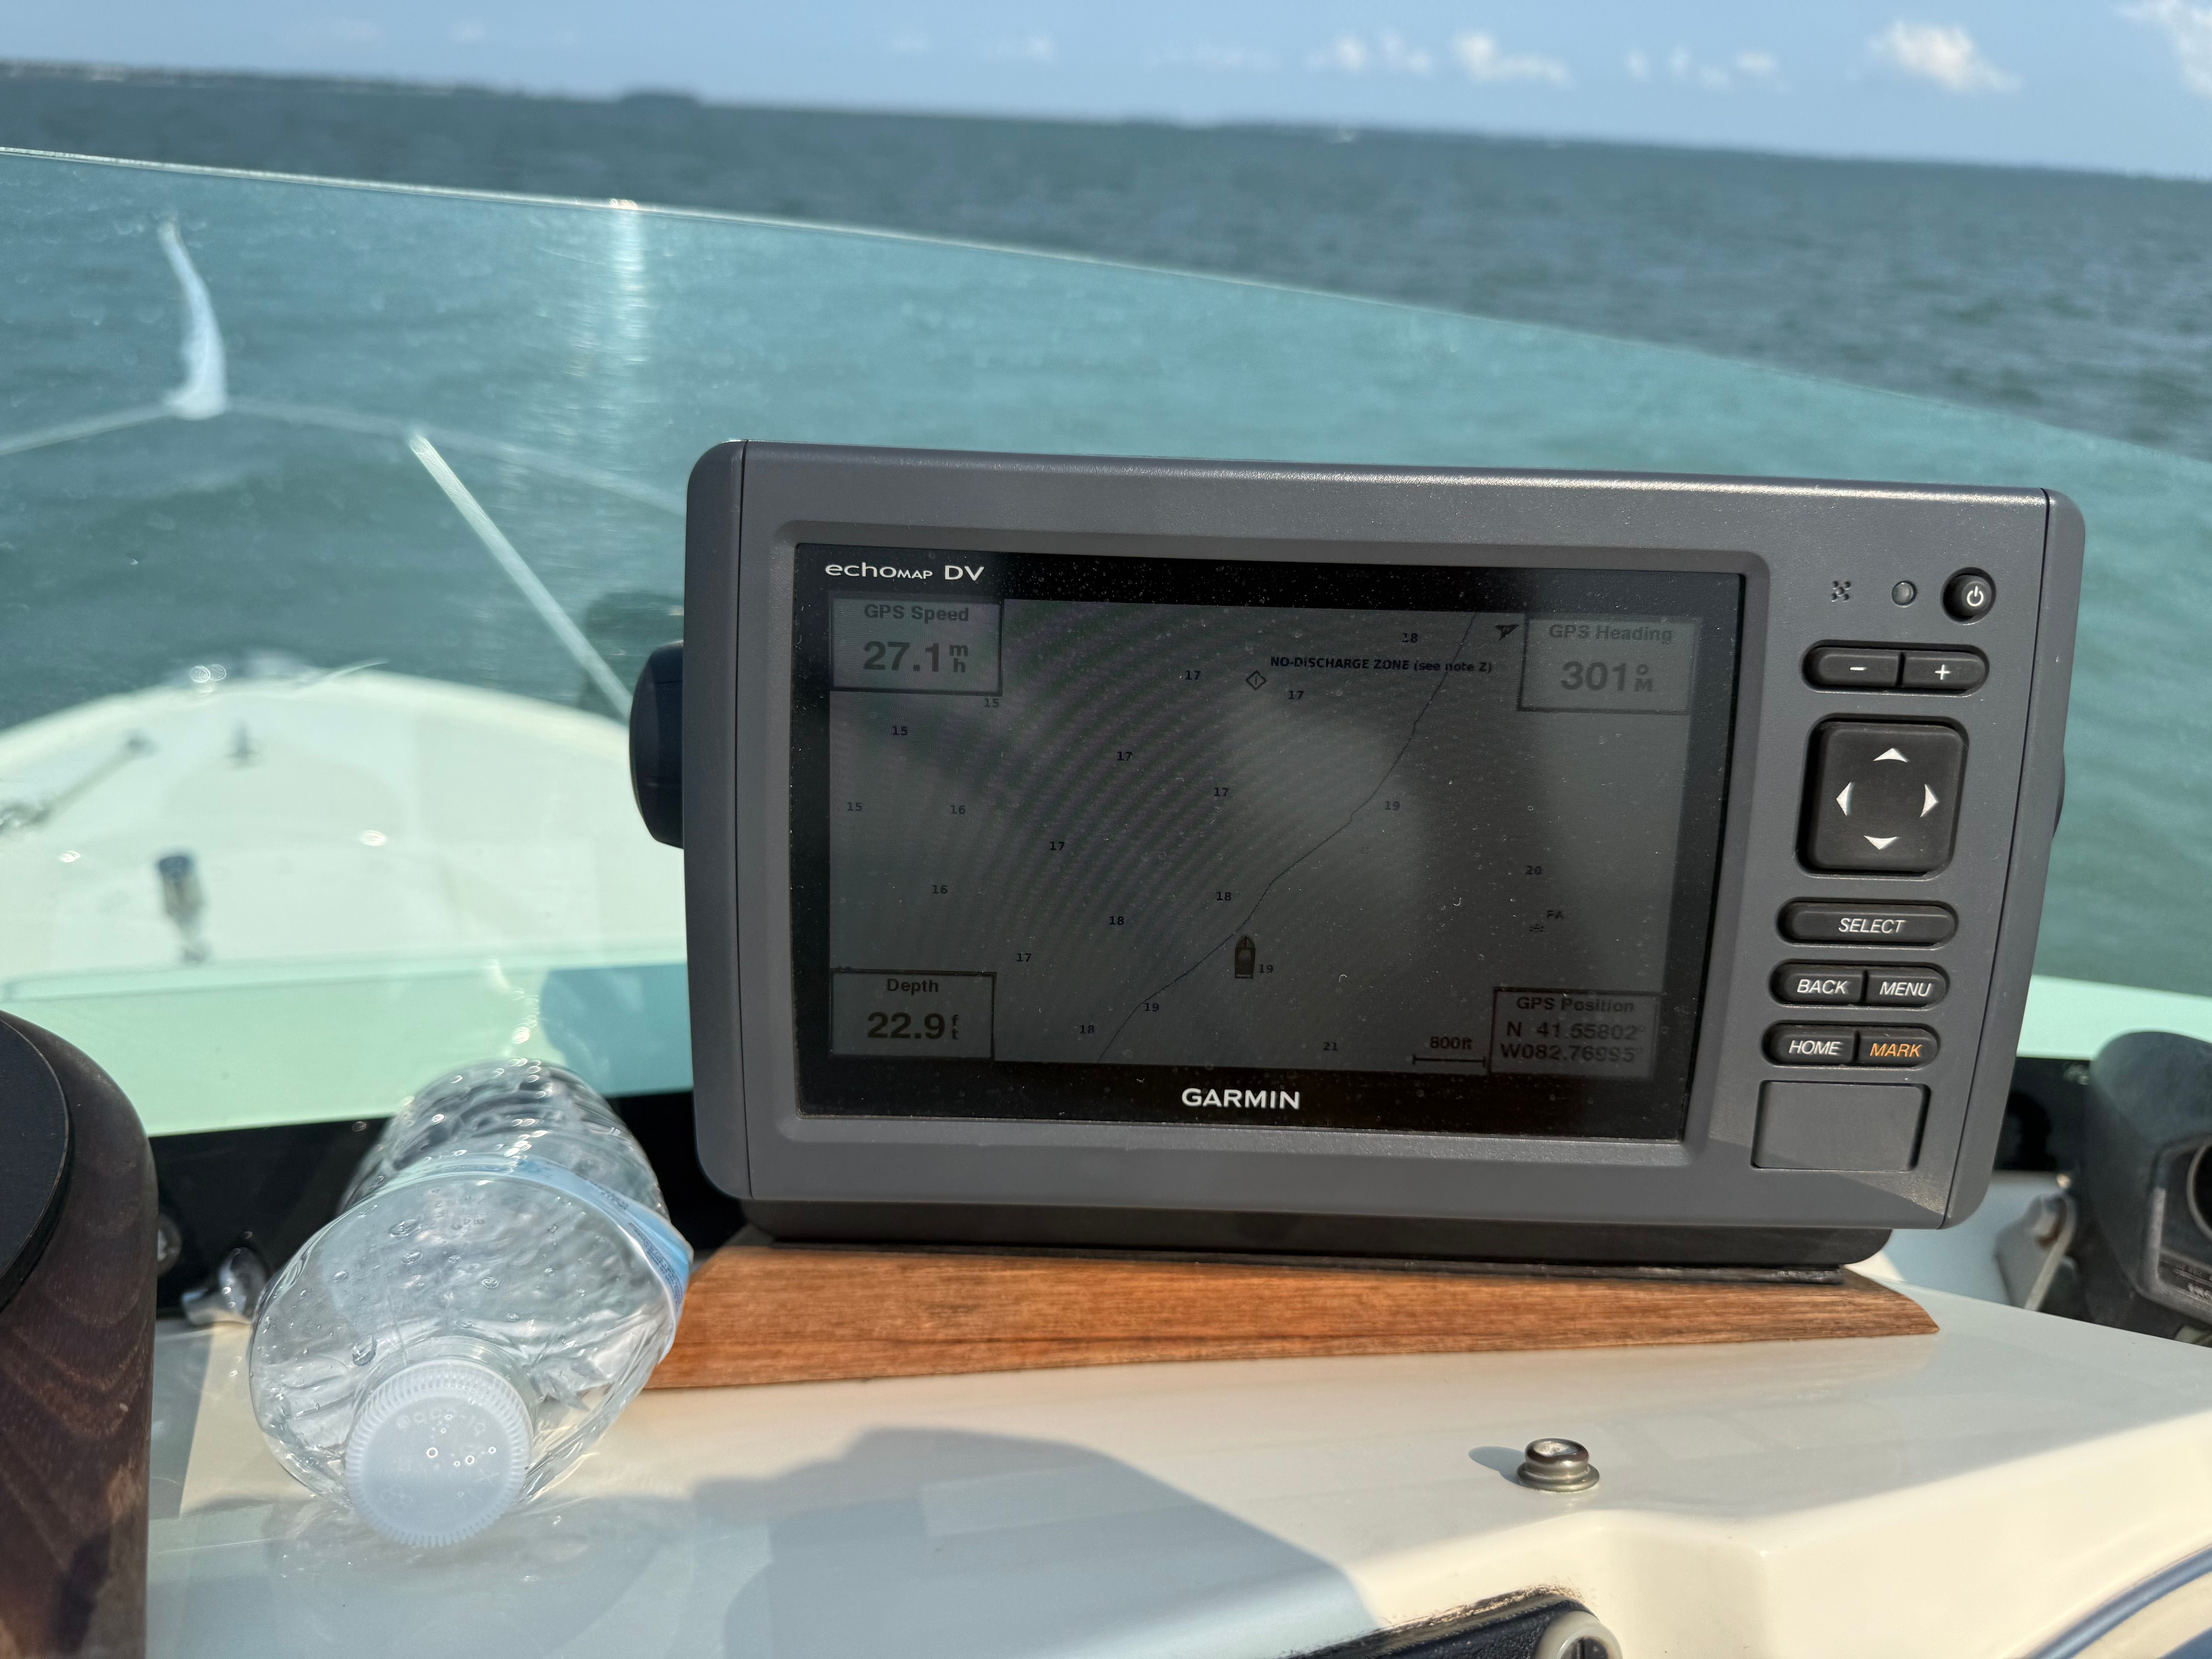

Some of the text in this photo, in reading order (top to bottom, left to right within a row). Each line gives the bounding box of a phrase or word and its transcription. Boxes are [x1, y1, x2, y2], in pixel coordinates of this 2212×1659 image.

[945, 565, 984, 581] DV
[864, 604, 969, 624] GPS Speed
[1402, 633, 1418, 642] 18
[1550, 624, 1673, 644] GPS Heading
[863, 641, 940, 672] 27.1
[1270, 657, 1369, 669] NO-DISCHARGE
[1374, 659, 1409, 670] ZONE
[1414, 661, 1440, 672] (see
[1446, 661, 1474, 672] note
[1185, 670, 1200, 680] 17
[1561, 661, 1626, 692] 301
[1288, 690, 1304, 700] 17
[984, 698, 999, 708] 15
[891, 726, 908, 736] 15
[1117, 751, 1132, 761] 17
[1214, 788, 1229, 797] 17
[847, 802, 863, 812] 15
[950, 805, 966, 814] 16
[1384, 801, 1400, 811] 19
[1049, 841, 1065, 851] 17
[1525, 865, 1542, 876] 20
[933, 885, 948, 894] 16
[1216, 892, 1232, 902] 18
[1109, 916, 1125, 926] 18
[1838, 918, 1907, 934] SELECT
[1016, 953, 1032, 962] 17
[1259, 964, 1274, 974] 19
[886, 978, 939, 995] Depth
[1796, 979, 1849, 994] BACK
[1879, 982, 1932, 997] MENU
[1144, 1003, 1159, 1012] 19
[1516, 996, 1635, 1013] GPS Position
[867, 1012, 945, 1039] 22.9
[1080, 1025, 1094, 1034] 18
[1506, 1020, 1522, 1037] N
[1323, 1042, 1338, 1051] 21
[1429, 1036, 1472, 1050] 800ft
[1788, 1040, 1843, 1056] HOME
[1869, 1043, 1923, 1058] MARK
[1181, 1087, 1301, 1110] GARMIN
